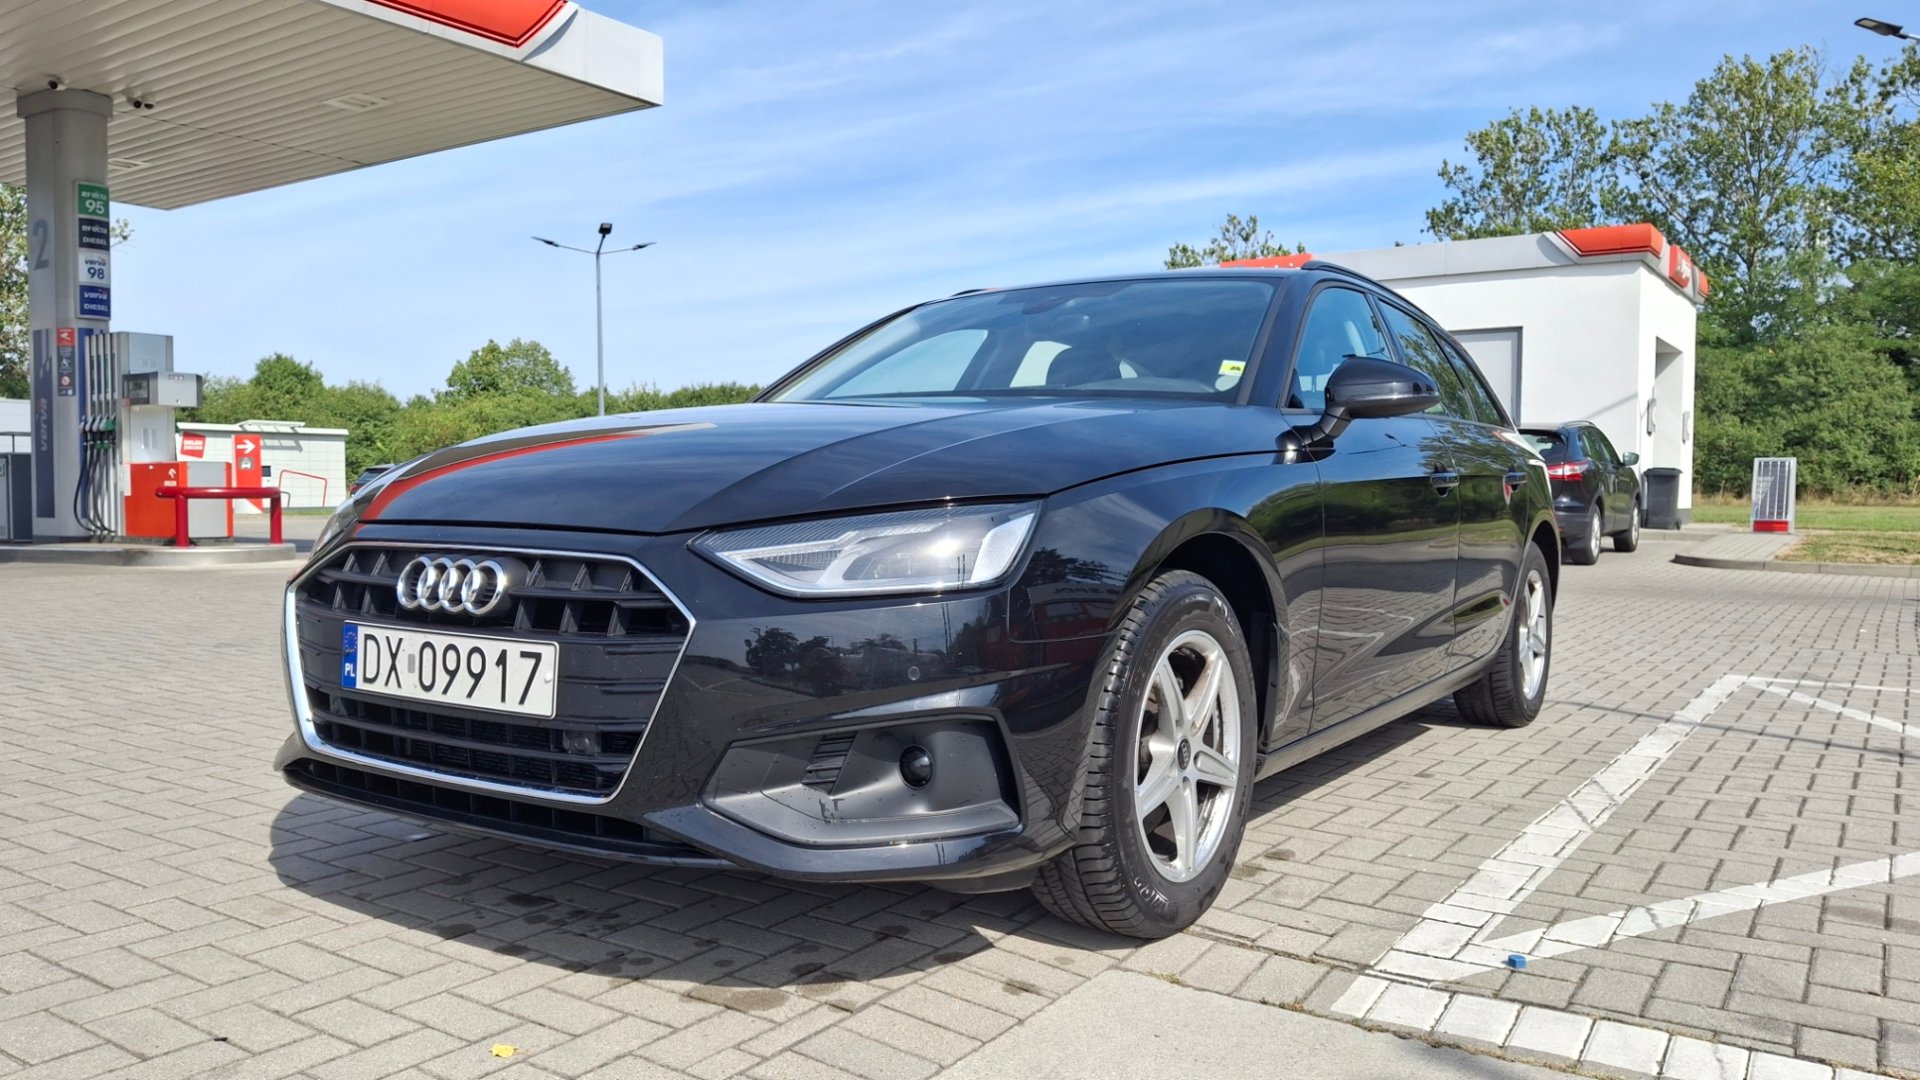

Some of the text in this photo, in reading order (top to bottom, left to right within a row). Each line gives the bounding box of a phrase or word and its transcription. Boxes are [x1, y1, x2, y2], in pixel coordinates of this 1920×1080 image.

[85, 199, 105, 214] 95
[32, 218, 49, 271] 2
[82, 236, 107, 245] DIESEL
[87, 267, 105, 280] 98
[83, 303, 108, 312] DIESEL
[344, 662, 356, 677] PL
[363, 633, 543, 706] DX 09917
